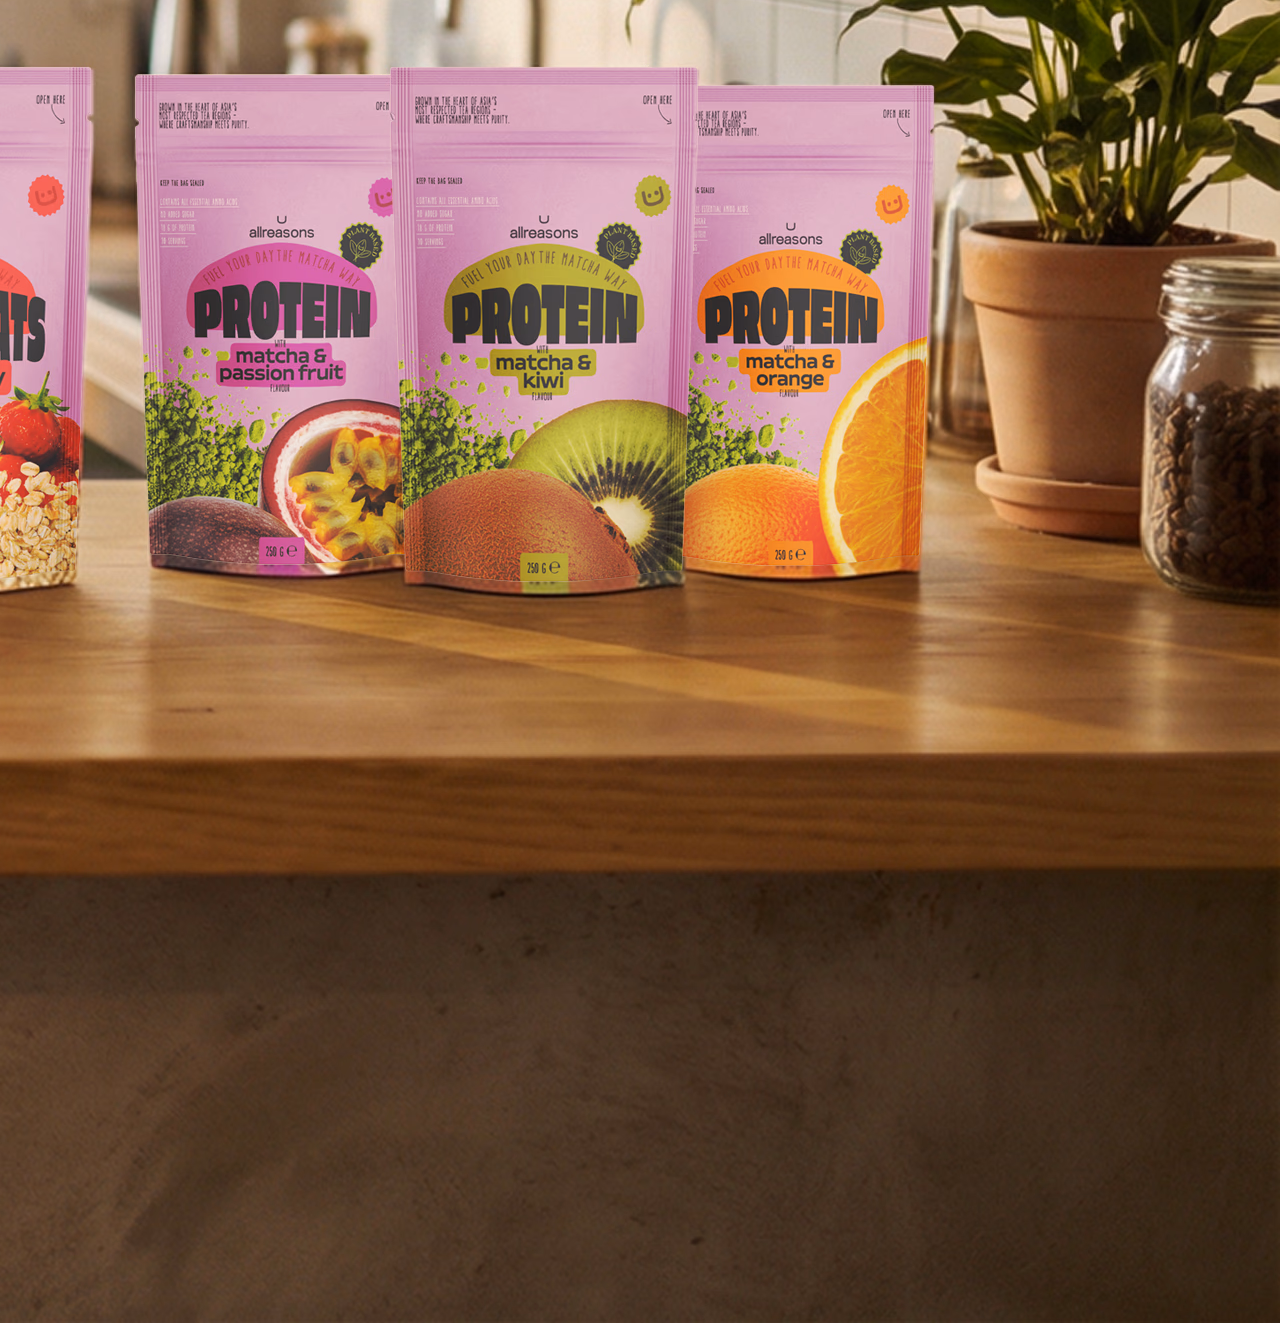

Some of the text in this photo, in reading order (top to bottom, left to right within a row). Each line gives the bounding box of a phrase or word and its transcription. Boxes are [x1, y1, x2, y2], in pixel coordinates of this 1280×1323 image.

[883, 109, 910, 118] OPEN HERE
[249, 226, 315, 239] allreasons
[510, 226, 578, 238] allreasons
[758, 233, 822, 244] allreasons
[346, 227, 378, 258] PLANT BASED
[603, 227, 636, 258] PLANT BASED
[847, 234, 878, 264] PLANT BASED
[194, 280, 371, 340] PROTEIN
[452, 283, 638, 346] PROTEIN
[705, 286, 878, 346] PROTEIN
[274, 340, 286, 348] WITH
[536, 346, 548, 354] WITH
[236, 348, 327, 364] matcha &
[496, 355, 591, 370] matcha &
[746, 353, 834, 369] matcha &
[220, 364, 343, 383] passion fruit
[524, 372, 564, 389] kiwi
[270, 384, 290, 392] FLAVOUR
[756, 374, 824, 390] orange
[532, 392, 552, 400] FLAVOUR
[780, 389, 798, 398] FLAVOUR
[266, 546, 284, 558] 250 G
[774, 550, 793, 560] 250 G
[527, 562, 546, 574] 250 G
